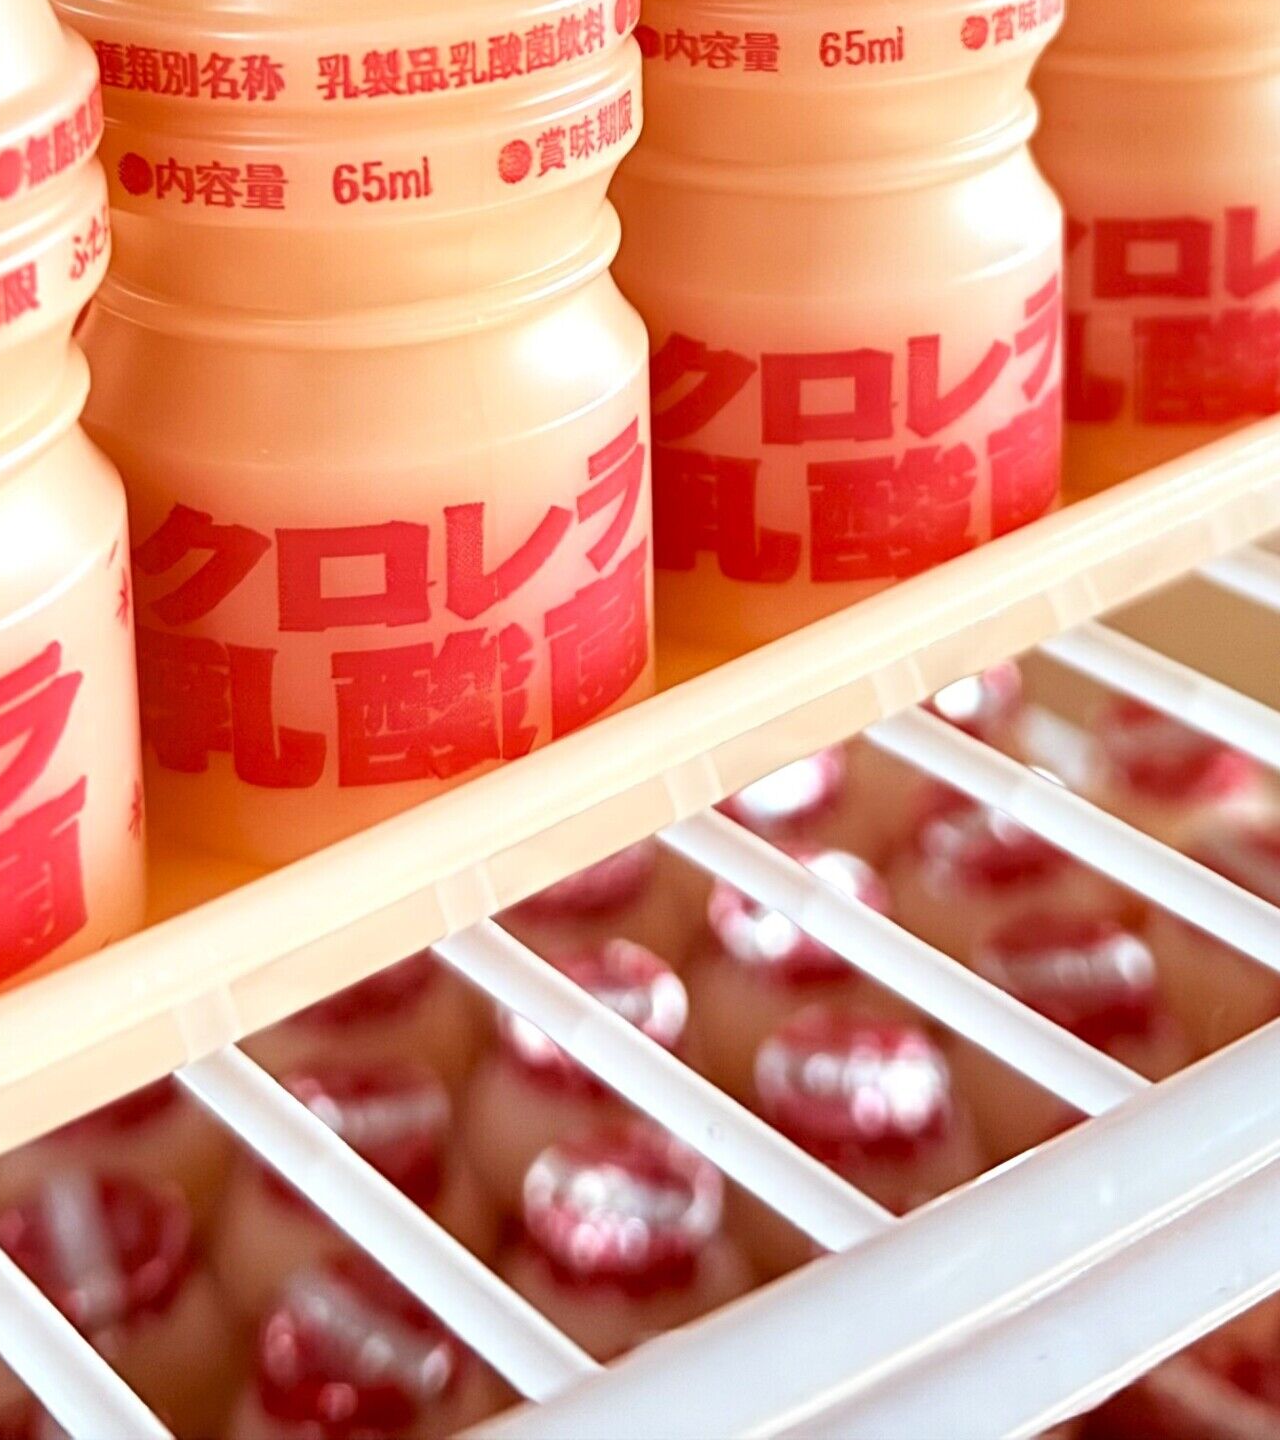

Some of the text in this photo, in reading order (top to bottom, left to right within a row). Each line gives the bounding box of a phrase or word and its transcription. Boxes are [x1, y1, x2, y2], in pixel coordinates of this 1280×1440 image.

[316, 3, 606, 101] 乳製品乳酸菌飲料
[664, 28, 781, 73] 内容量
[818, 25, 906, 69] 65ml
[154, 159, 289, 210] 内容量
[331, 157, 433, 205] 65ml
[654, 272, 1058, 447] クロレラ
[135, 414, 646, 633] クロレラ
[135, 535, 648, 790] 乳酸菌
